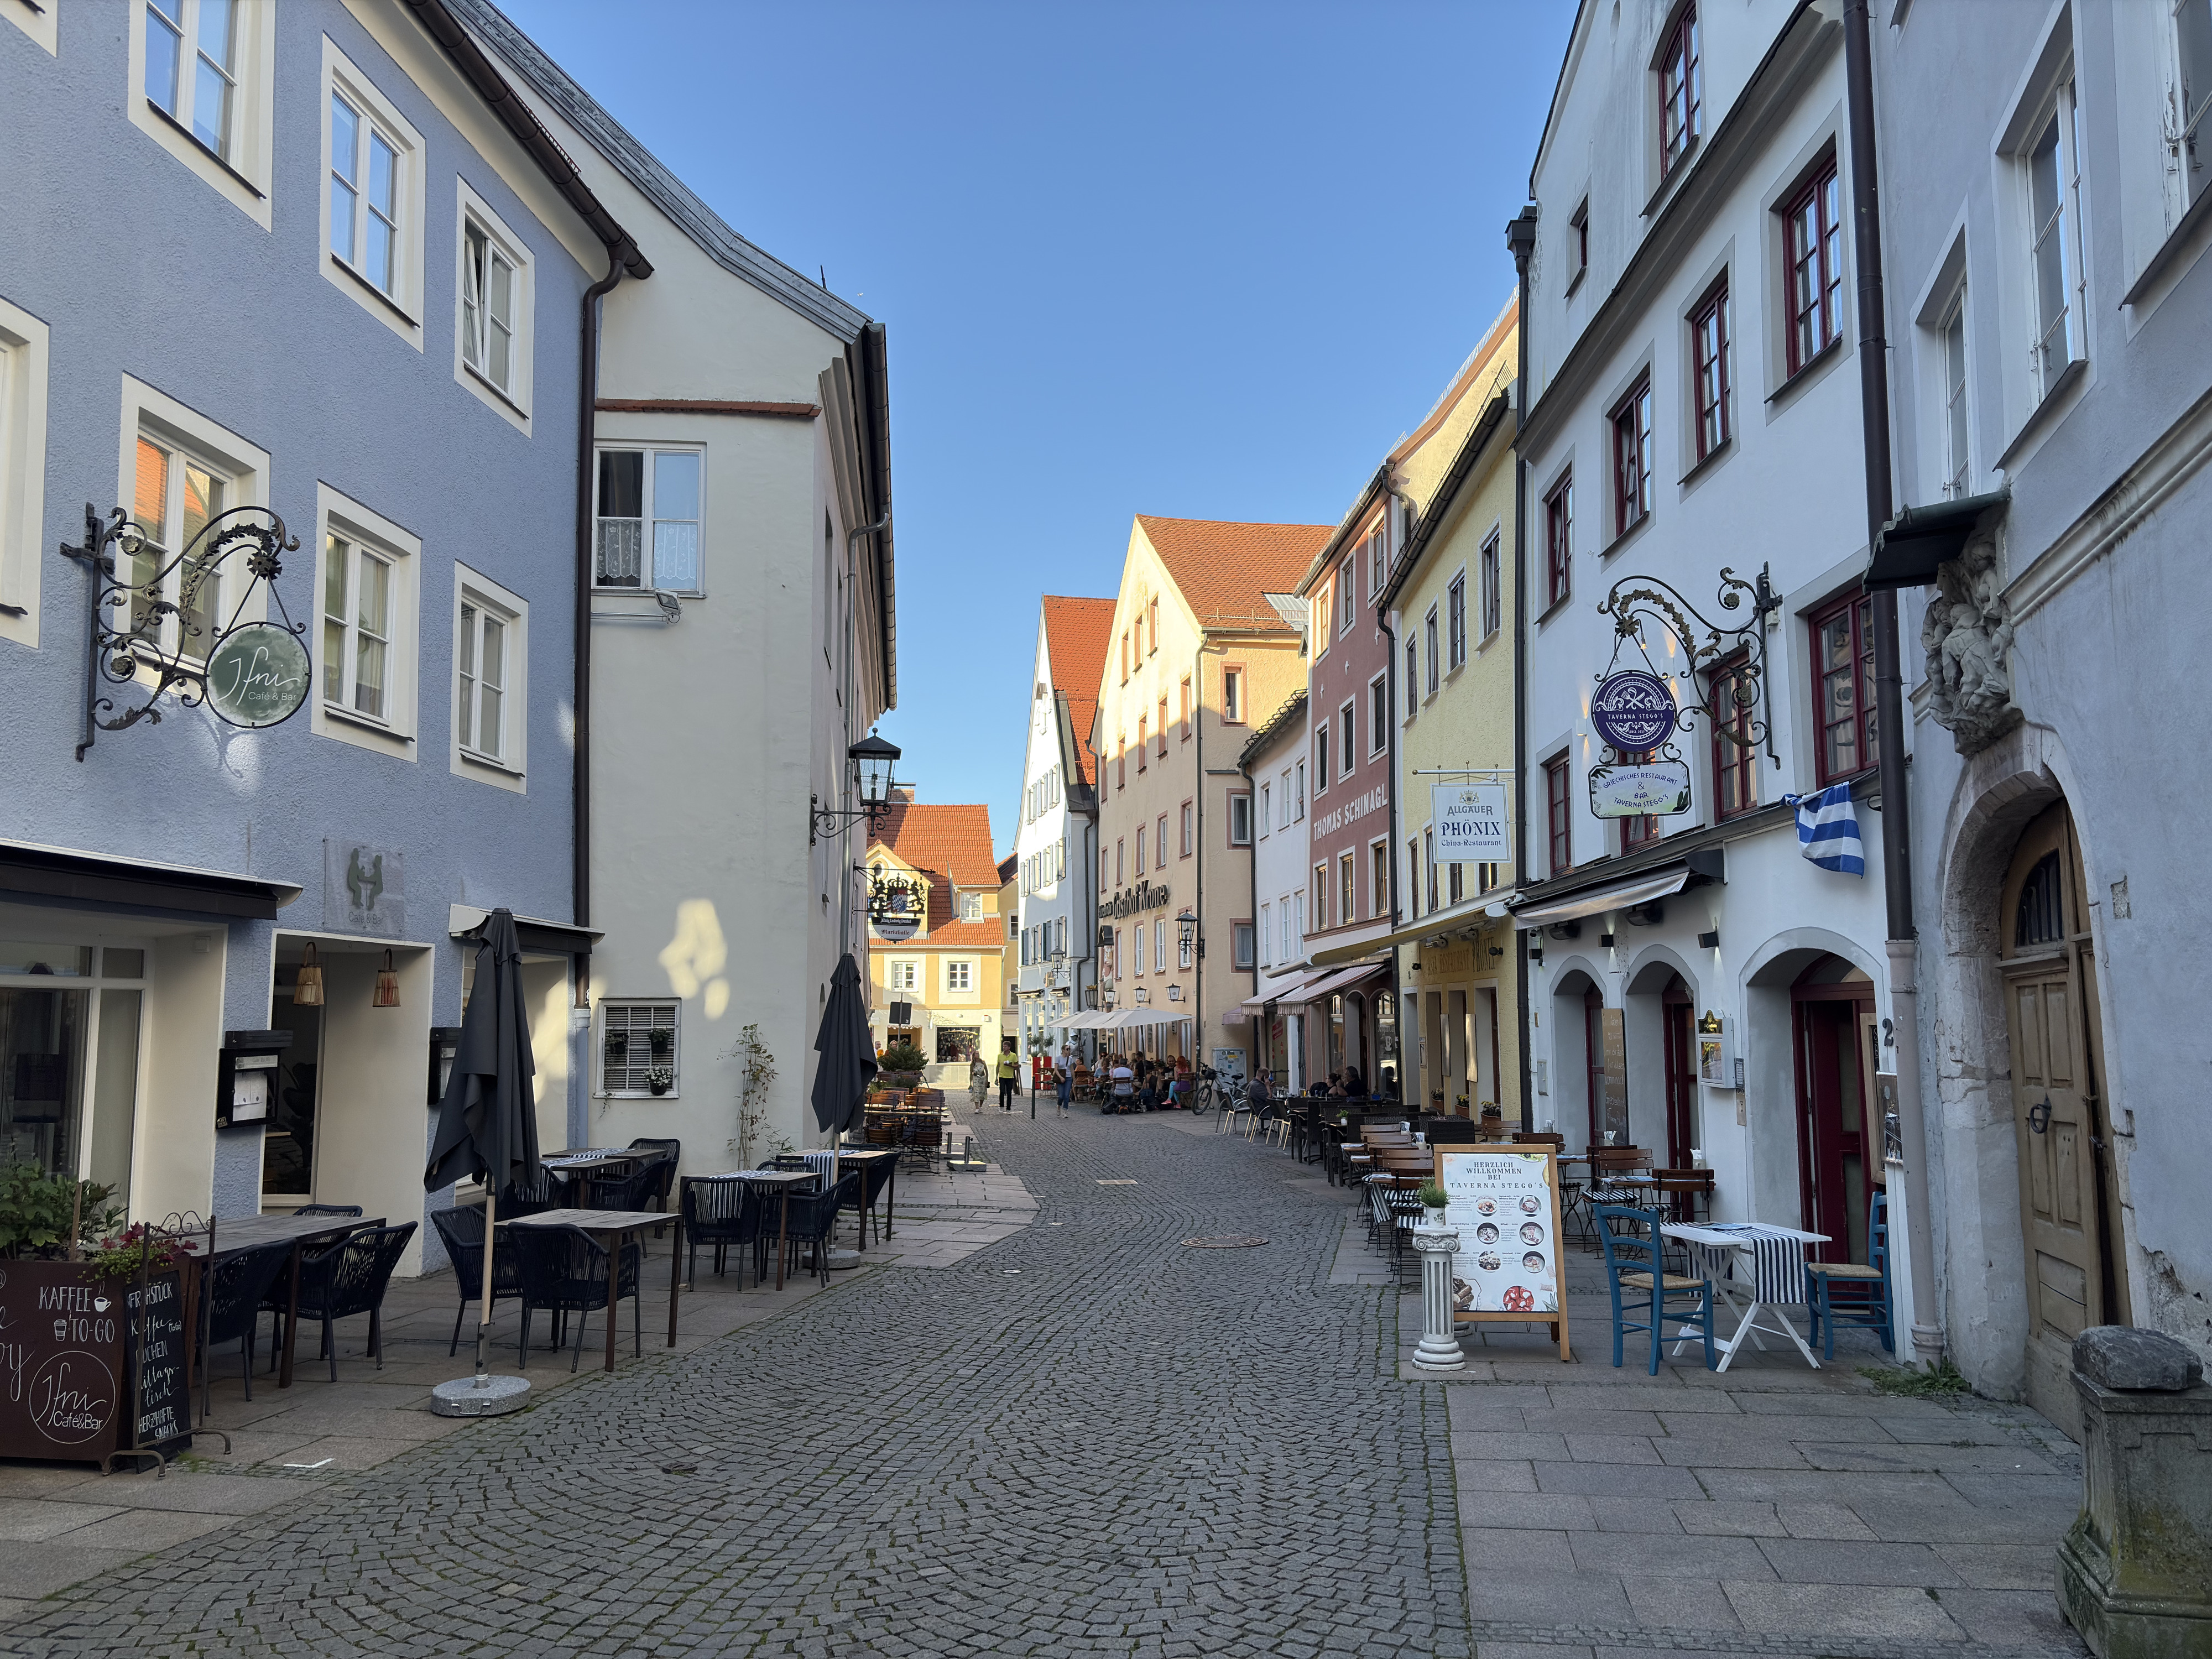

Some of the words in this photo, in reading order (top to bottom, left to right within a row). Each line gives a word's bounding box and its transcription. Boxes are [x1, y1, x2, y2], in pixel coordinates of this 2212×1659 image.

[248, 692, 270, 700] Café
[281, 692, 297, 701] Bar
[1603, 773, 1640, 789] GRIECHISCHES
[1641, 773, 1678, 785] RESTAURANT
[1637, 781, 1645, 790] &
[1313, 808, 1342, 842] THOMAS
[1344, 783, 1388, 826] SCHINAGL
[1447, 805, 1494, 816] ALLGÄUER
[1614, 797, 1642, 808] TAVERNA
[1643, 794, 1668, 807] STEGO'S
[1440, 819, 1501, 836] PHÖNIX
[1441, 839, 1501, 847] China-Restaurant
[1113, 884, 1141, 920] Gasthof
[1140, 880, 1168, 911] Krone
[366, 913, 372, 924] &
[1882, 1018, 1893, 1046] 2
[39, 1286, 92, 1312] KAFFEE
[128, 1281, 173, 1309] FRHSTÜCK
[71, 1318, 114, 1343] TO-GO
[131, 1315, 172, 1342] Kffee
[136, 1340, 168, 1363] UCHEN
[139, 1365, 180, 1390] ittags-
[144, 1382, 180, 1407] tisch
[138, 1406, 175, 1434] HERZHAFTE
[155, 1420, 179, 1439] SNACKS
